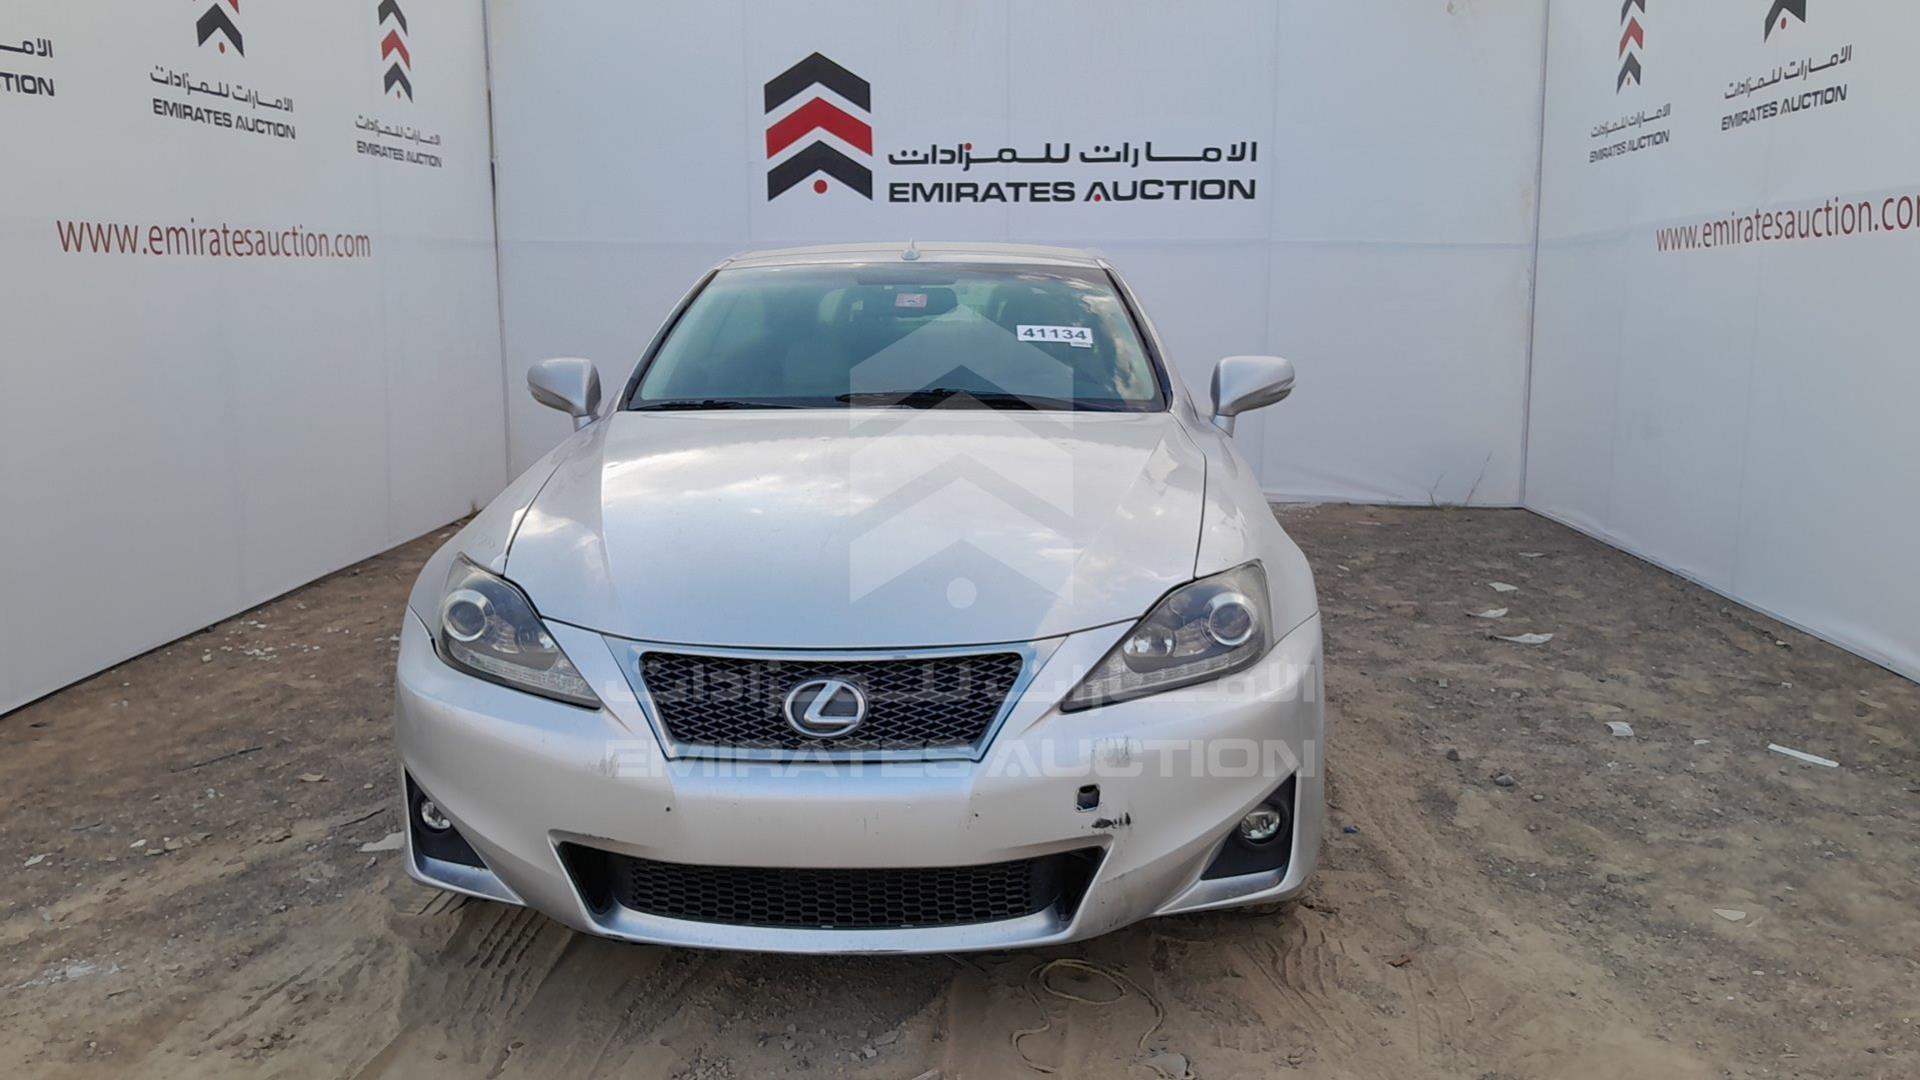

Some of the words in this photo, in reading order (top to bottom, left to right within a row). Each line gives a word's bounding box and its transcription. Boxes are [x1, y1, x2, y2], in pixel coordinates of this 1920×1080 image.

[0, 72, 55, 96] TION
[153, 98, 232, 128] EMIRATES
[235, 115, 296, 139] AUCTION
[1721, 101, 1778, 131] EMIRATES
[1780, 84, 1848, 115] AUCTION
[356, 140, 404, 161] EMIRATES
[888, 142, 1071, 172] للمزادات
[1079, 141, 1258, 168] الامارات
[888, 182, 1076, 203] EMIRATES
[1083, 179, 1256, 202] AUCTION
[1655, 194, 1920, 252] www.emiratesauction.co
[57, 218, 372, 258] www.emiratesauction.com
[1023, 327, 1087, 340] 41134
